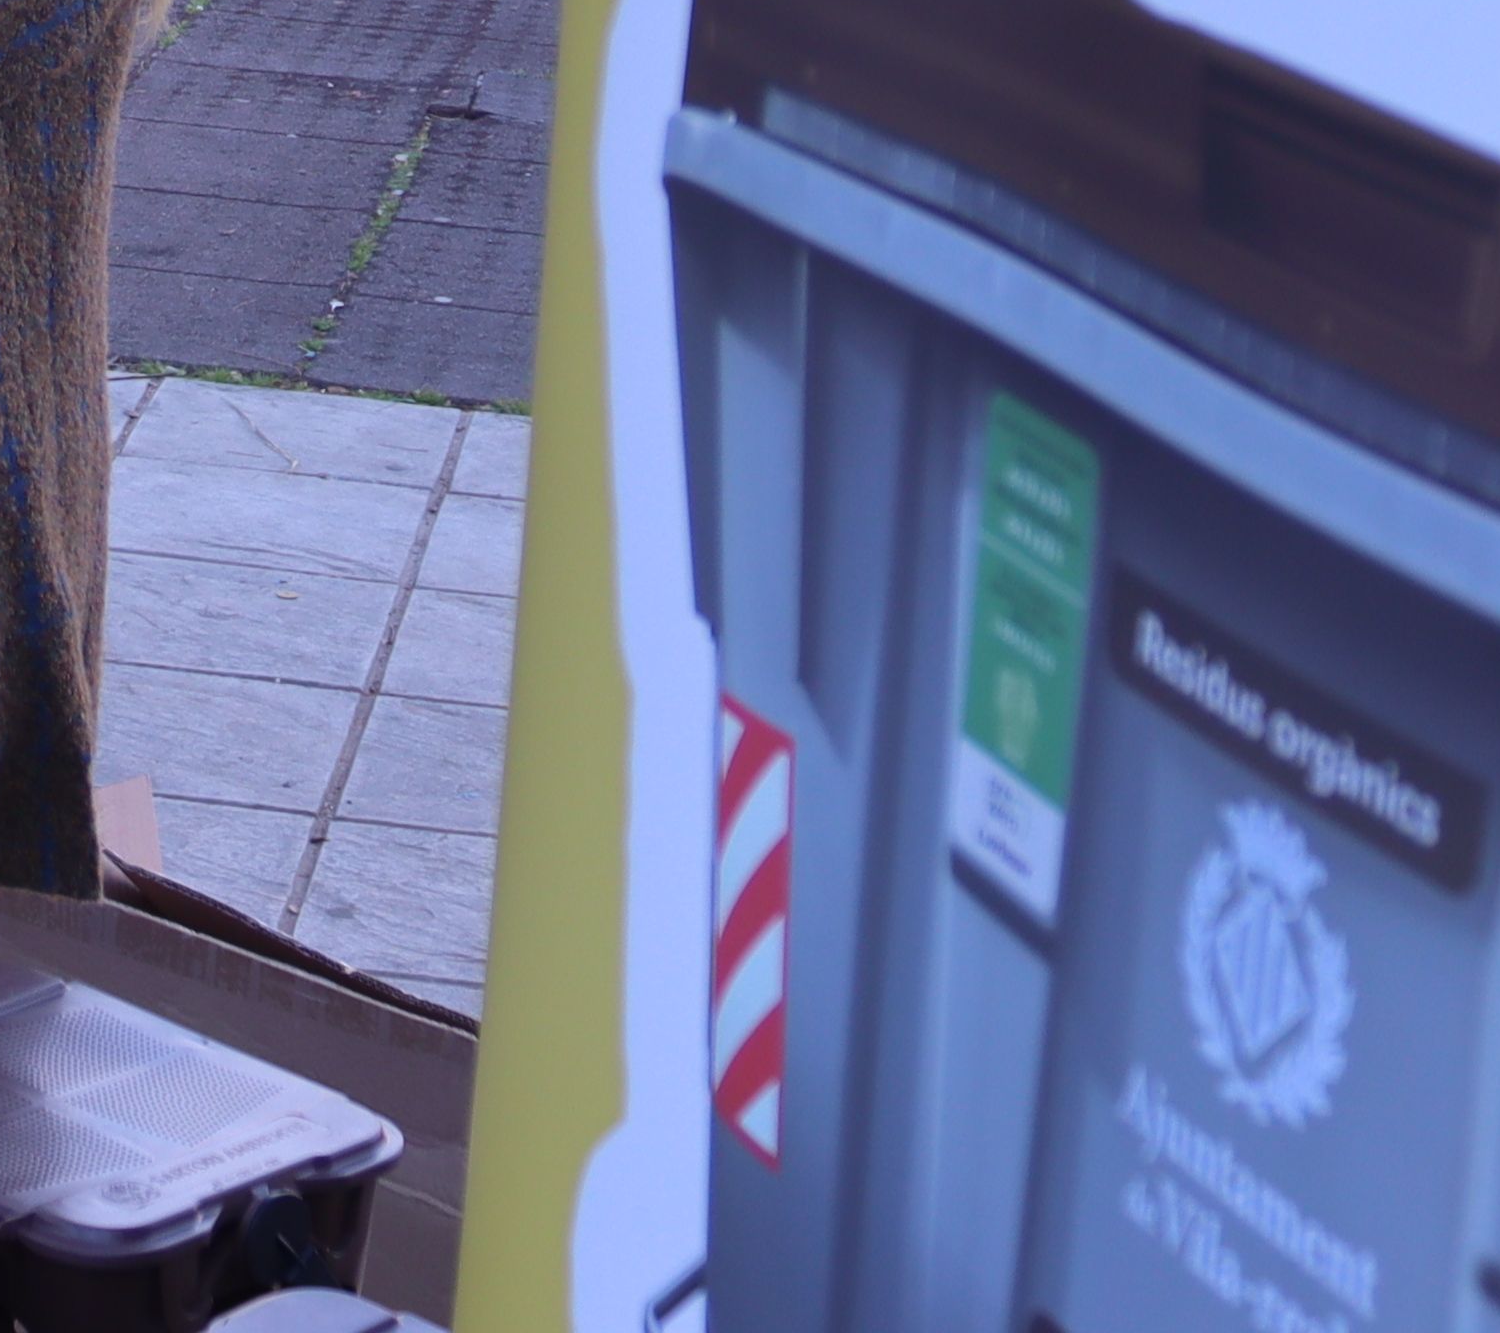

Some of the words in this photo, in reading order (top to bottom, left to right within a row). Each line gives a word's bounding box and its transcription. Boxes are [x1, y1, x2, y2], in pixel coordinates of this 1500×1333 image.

[1134, 609, 1265, 741] Residus
[1266, 707, 1442, 849] orgànics
[1116, 1061, 1377, 1321] Ajuntament
